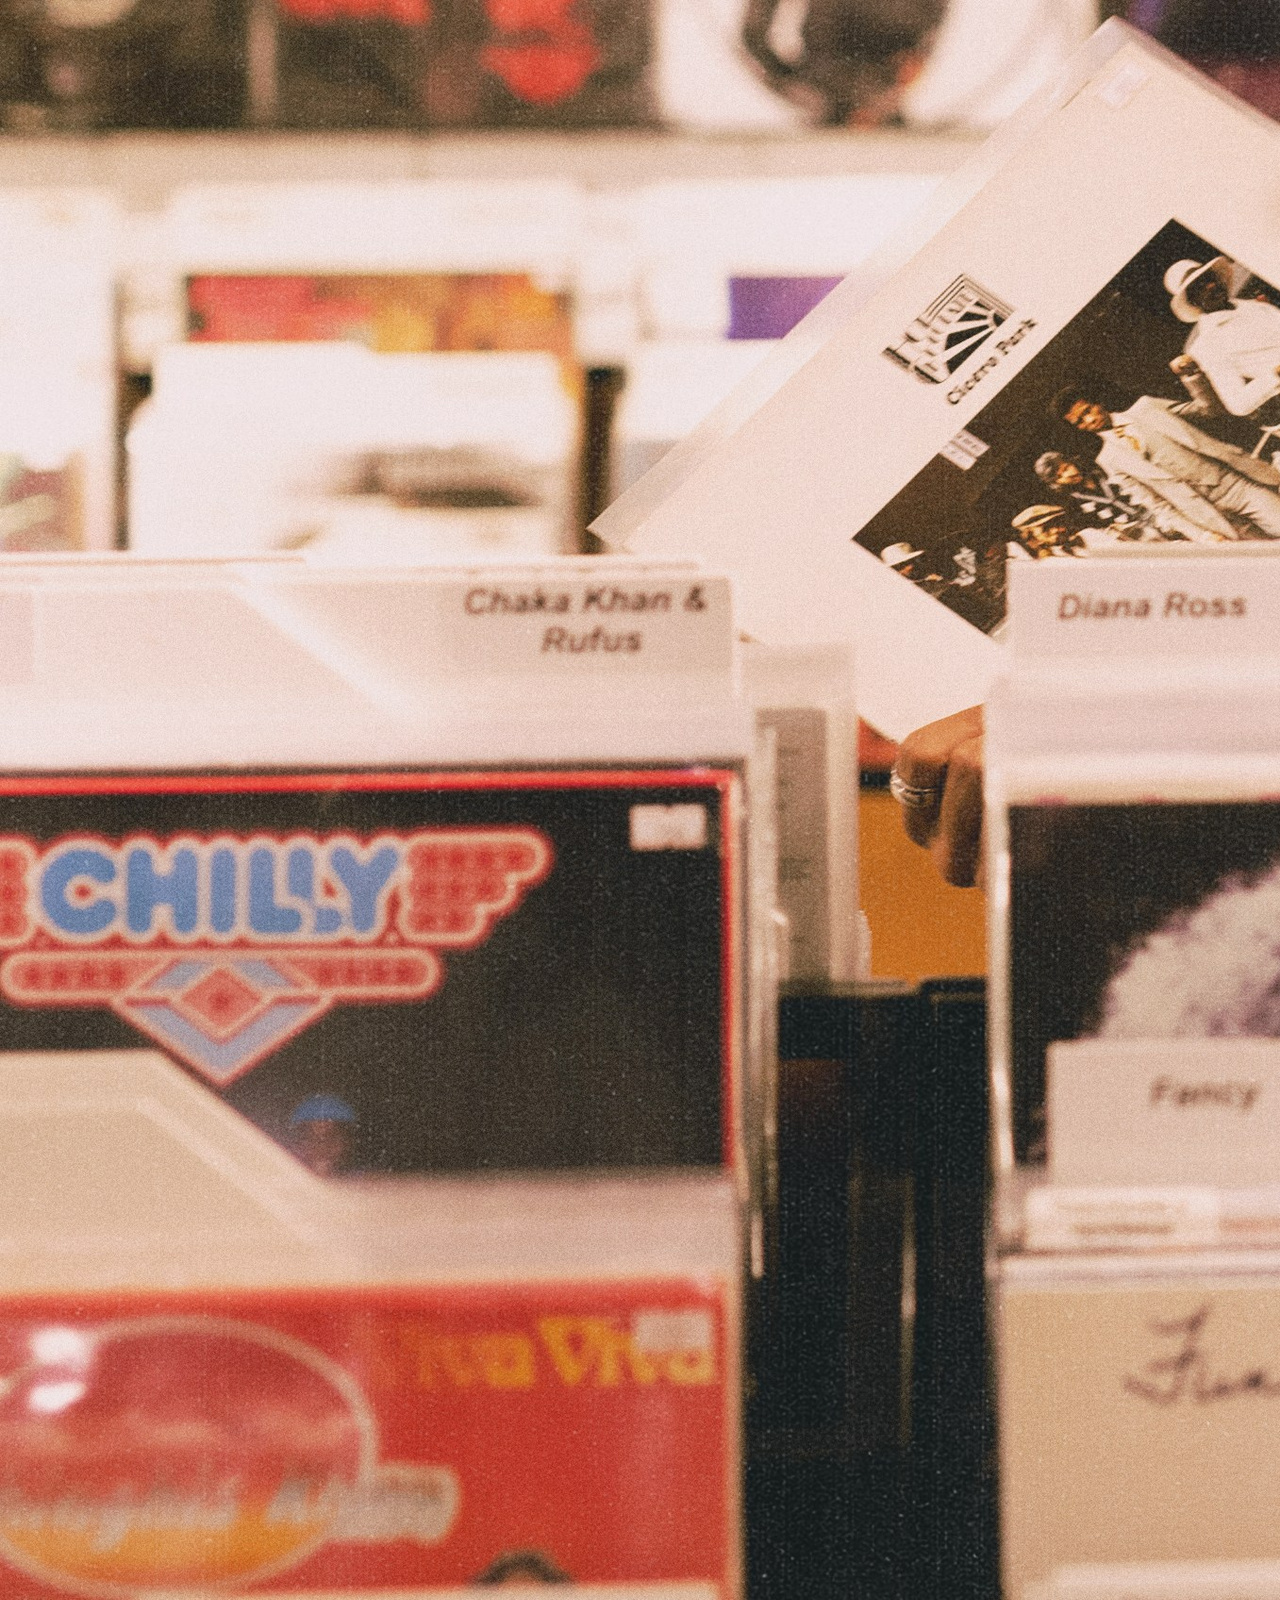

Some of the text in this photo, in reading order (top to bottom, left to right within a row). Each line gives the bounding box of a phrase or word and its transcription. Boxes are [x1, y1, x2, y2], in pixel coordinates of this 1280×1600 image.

[946, 317, 1038, 406] Cicero Park
[464, 583, 707, 616] Chaka Khan &
[1058, 591, 1248, 621] Diana Ross
[542, 625, 643, 653] Rufus
[34, 843, 401, 938] CHILLY
